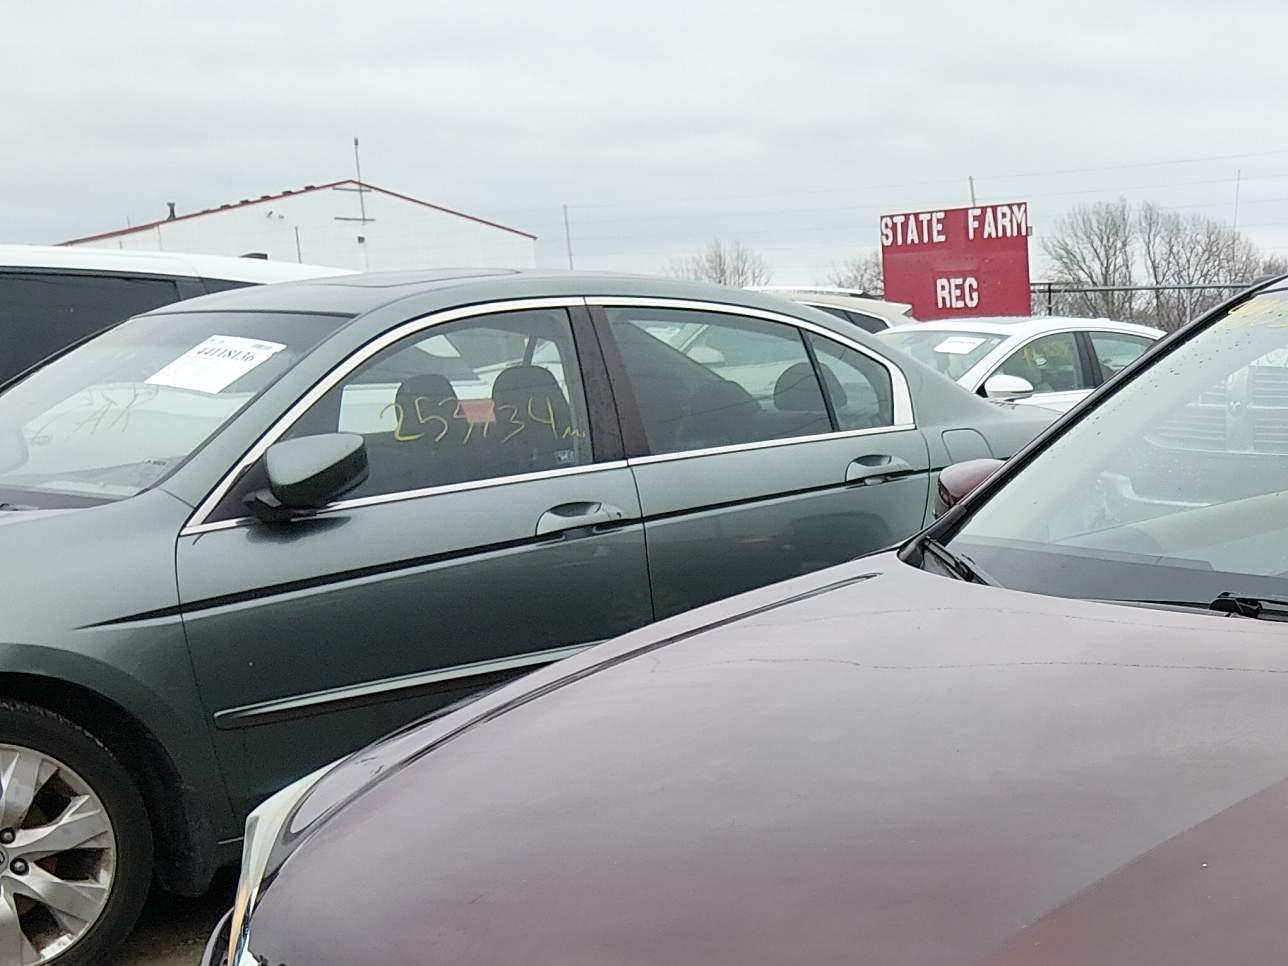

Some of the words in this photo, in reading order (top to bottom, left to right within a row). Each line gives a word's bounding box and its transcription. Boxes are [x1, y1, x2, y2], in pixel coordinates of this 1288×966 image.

[881, 211, 946, 246] STATE
[967, 204, 1027, 240] FARM
[936, 276, 979, 308] REG
